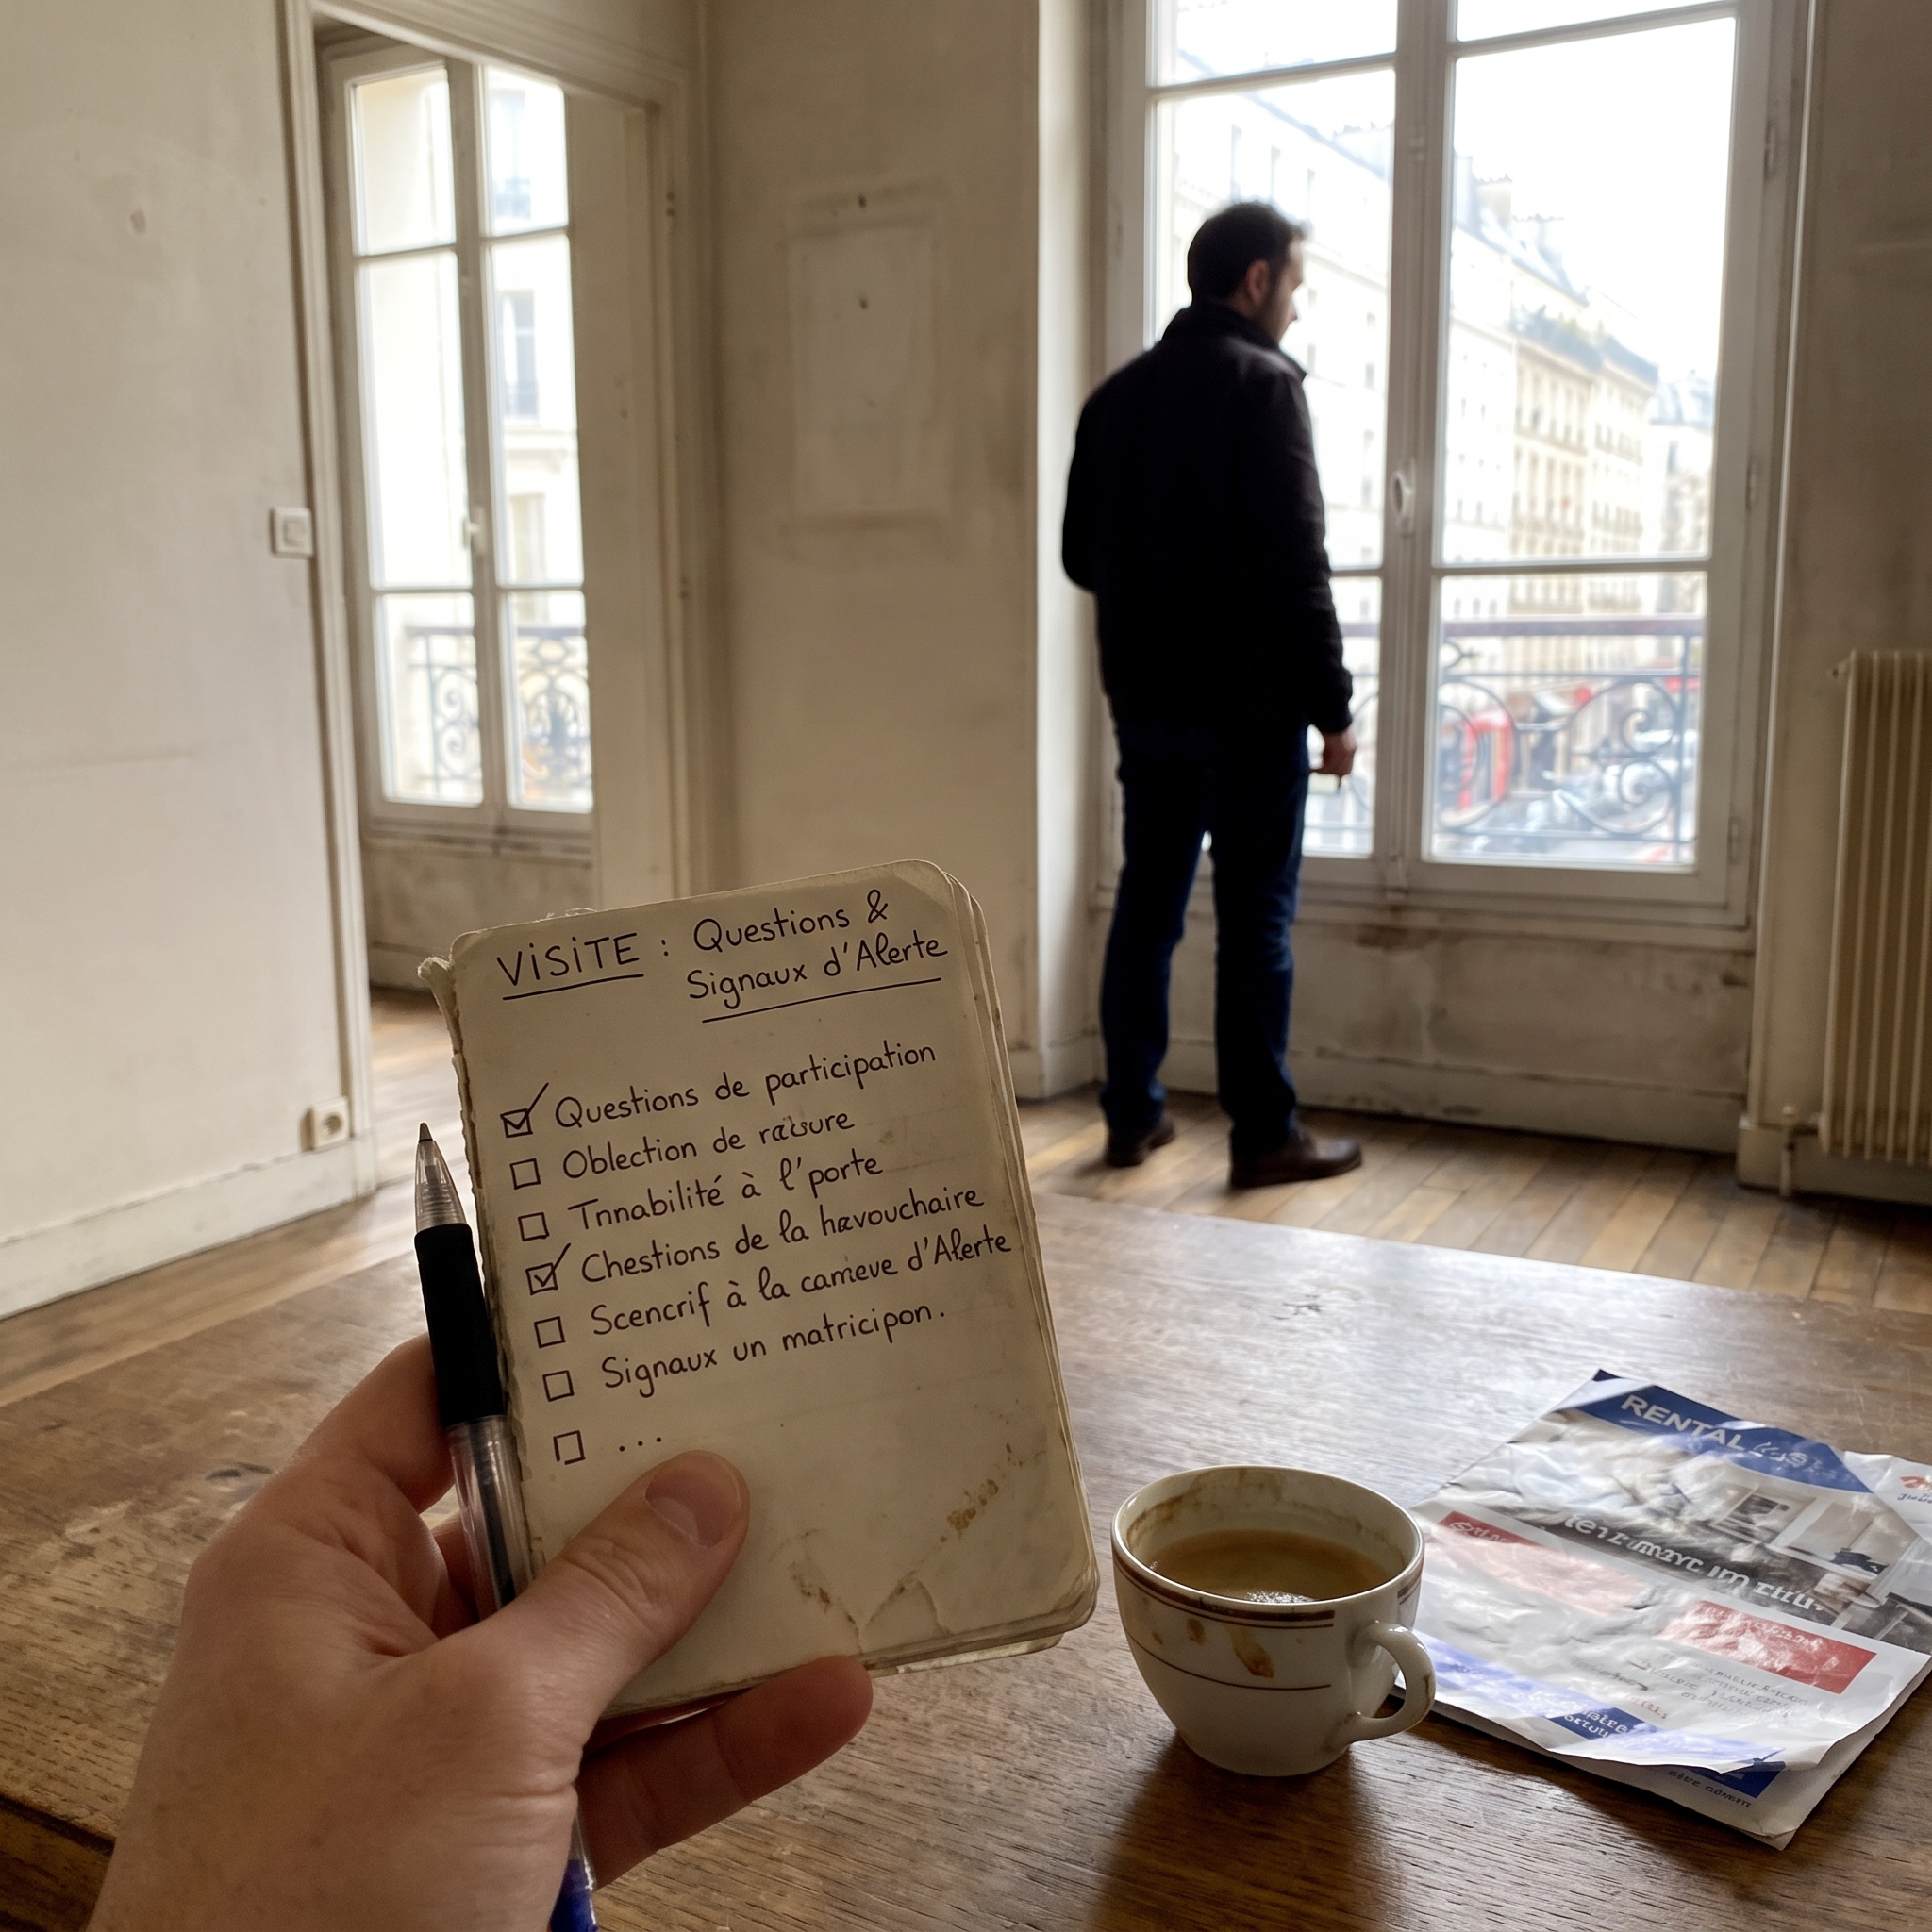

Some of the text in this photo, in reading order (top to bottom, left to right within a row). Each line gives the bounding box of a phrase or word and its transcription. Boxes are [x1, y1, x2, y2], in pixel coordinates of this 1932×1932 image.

[693, 907, 851, 954] Questions
[866, 889, 889, 924] &
[686, 929, 949, 1010] Signaux d'Alerte
[554, 1039, 936, 1129] Questions de participation
[712, 1125, 746, 1154] de
[741, 1171, 762, 1199] à
[581, 1239, 721, 1283] Chestions
[734, 1224, 770, 1255] de
[778, 1208, 810, 1244] la
[726, 1279, 747, 1308] à
[758, 1265, 791, 1302] la
[907, 1227, 1012, 1272] d'Alerte
[601, 1348, 718, 1399] Signaux
[733, 1340, 767, 1362] un
[1620, 1393, 1746, 1453] RENTAL
